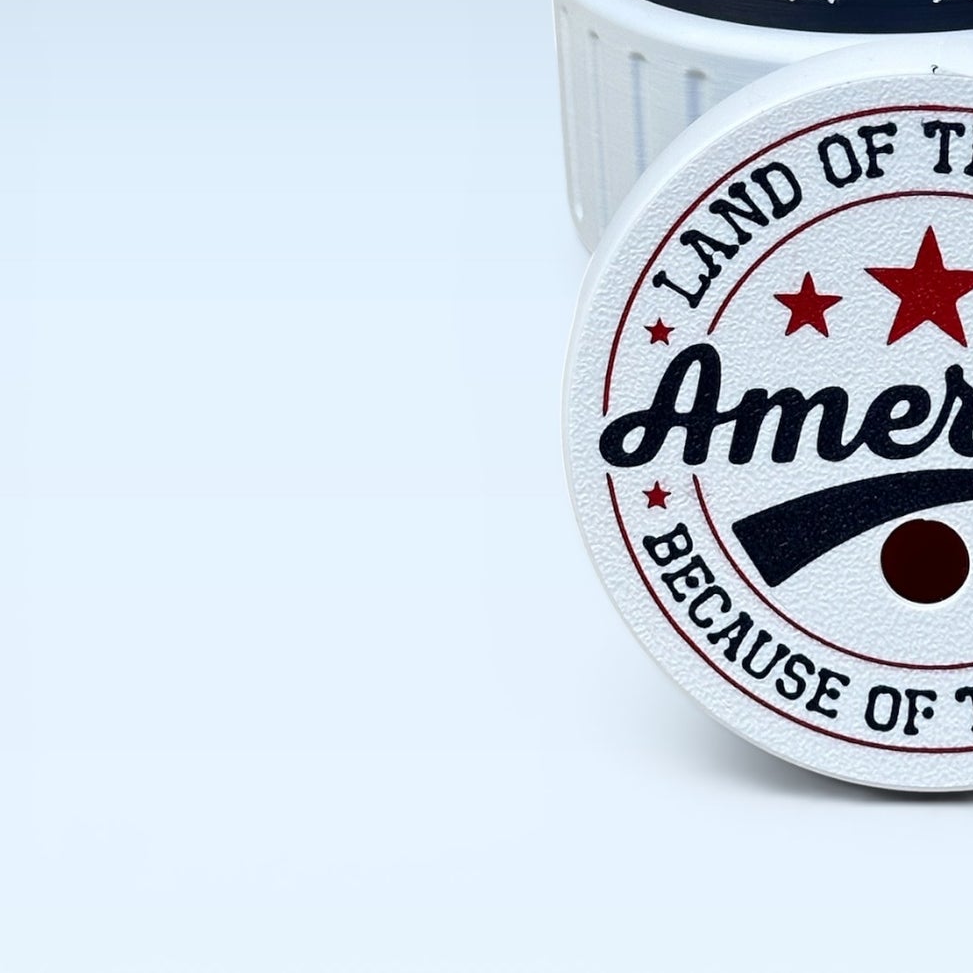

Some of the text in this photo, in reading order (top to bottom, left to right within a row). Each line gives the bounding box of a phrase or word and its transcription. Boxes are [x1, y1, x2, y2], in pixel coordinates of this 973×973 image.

[652, 161, 803, 309] LAND
[817, 121, 898, 189] OF
[642, 522, 850, 719] BECAUSE
[864, 684, 938, 736] OF
